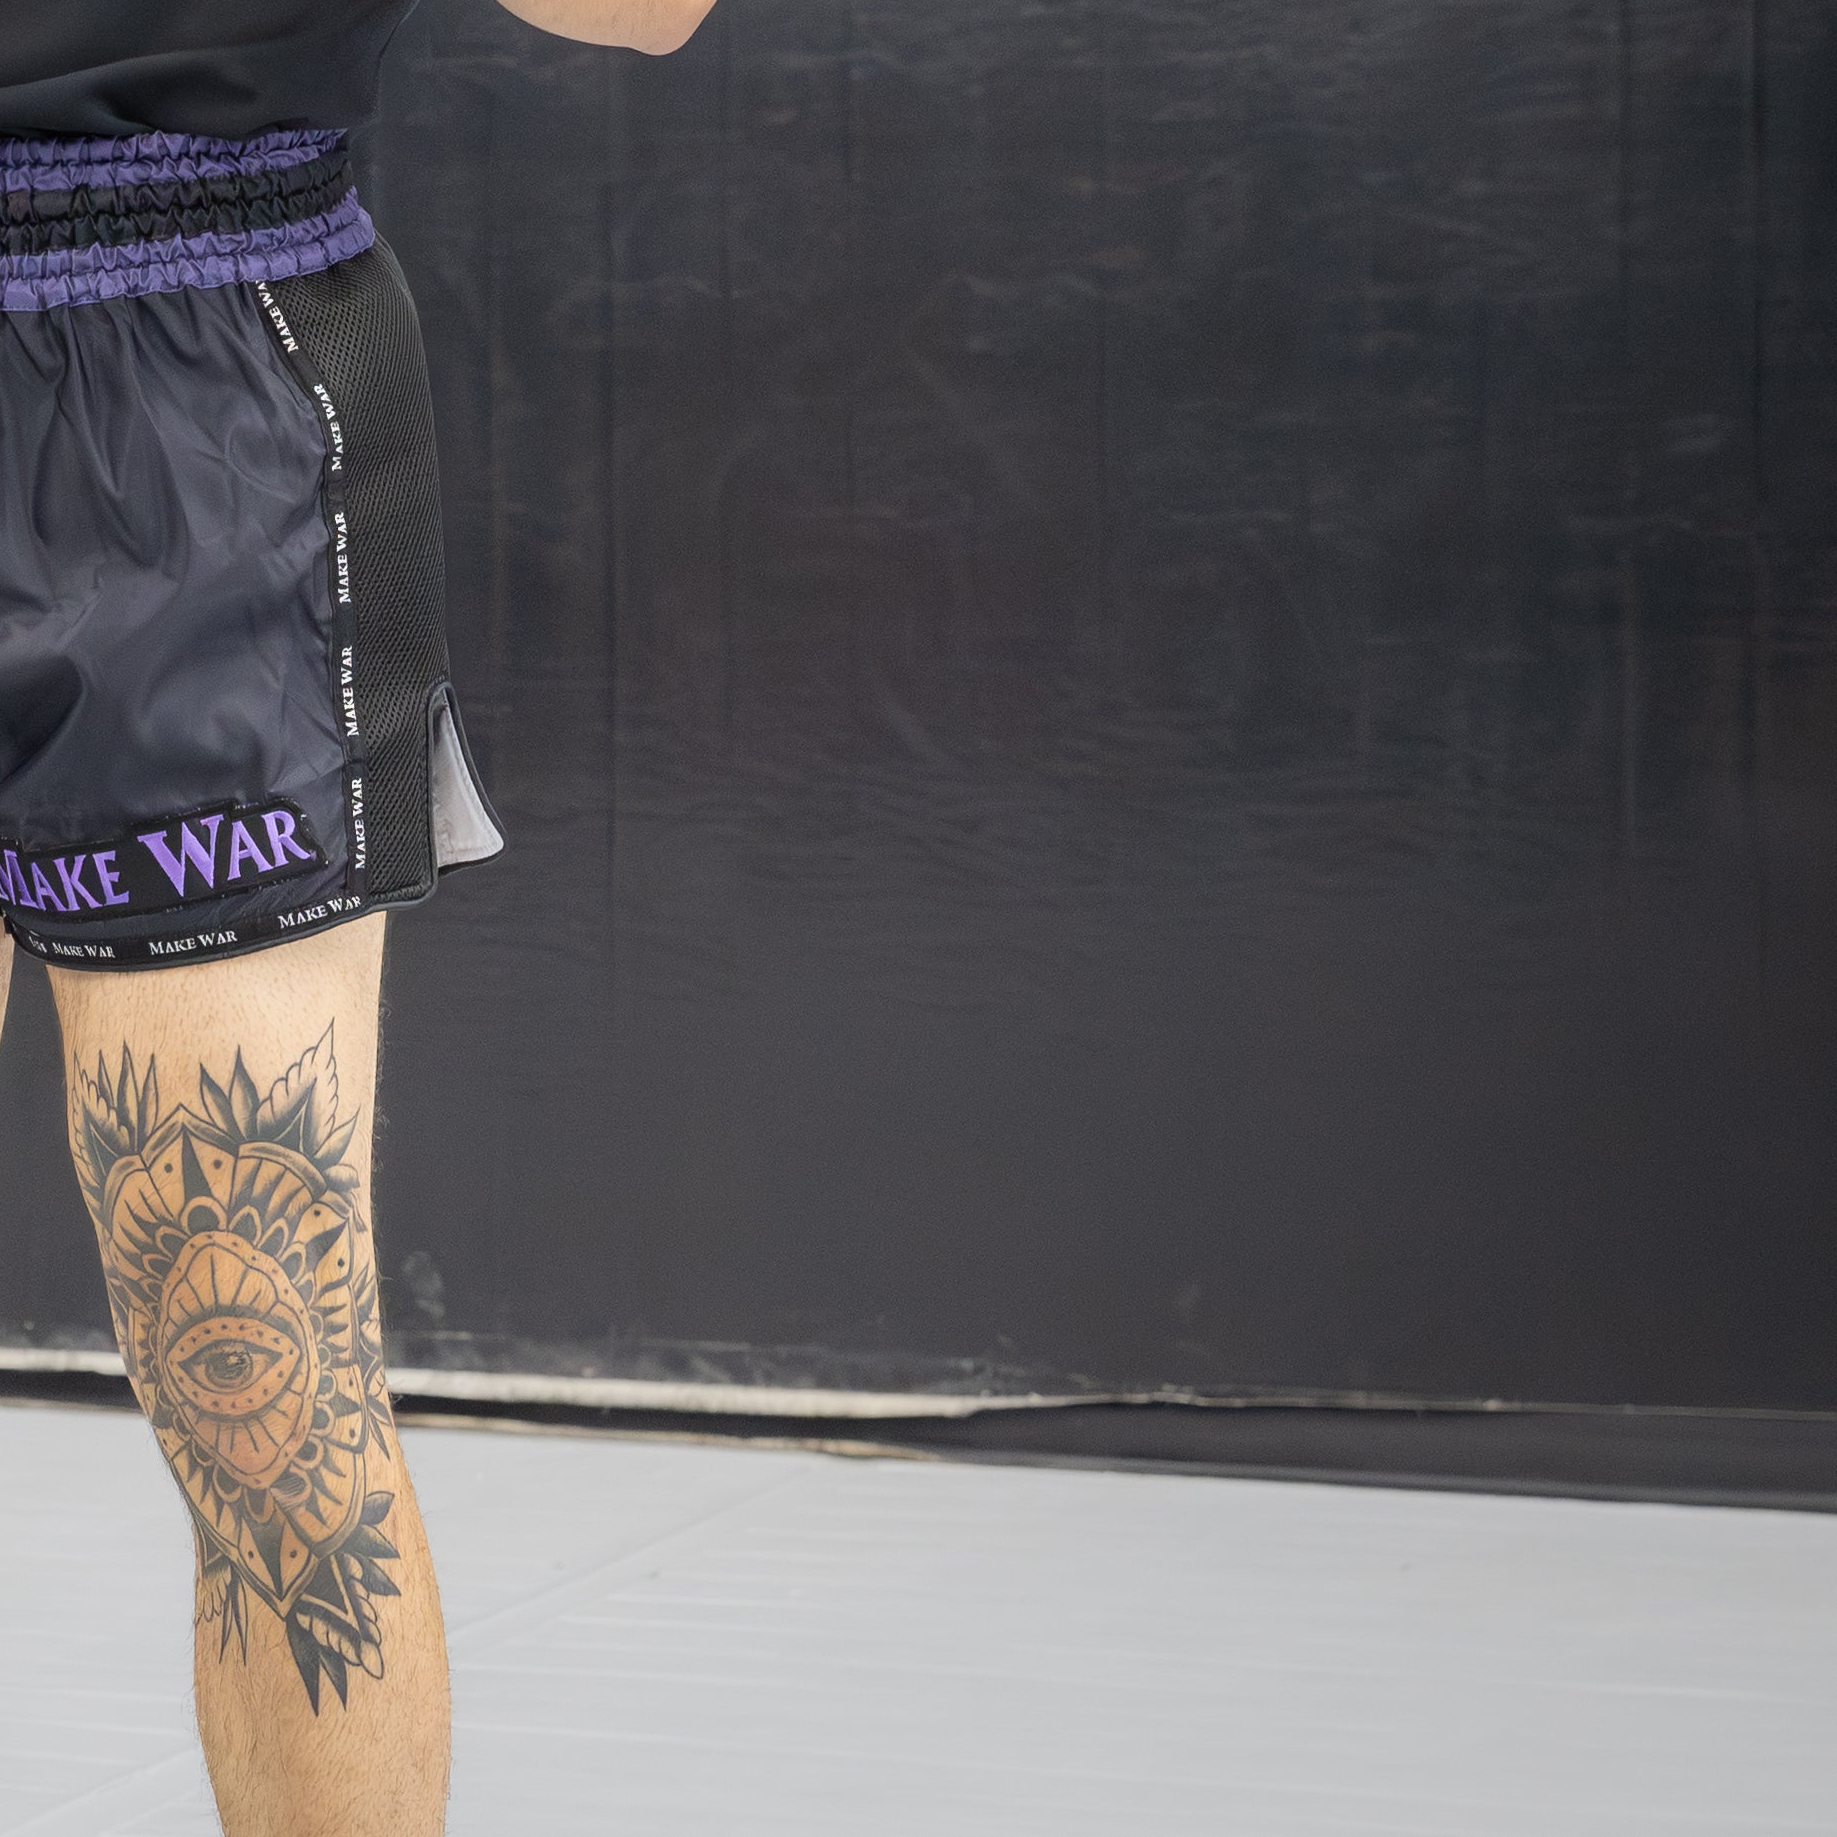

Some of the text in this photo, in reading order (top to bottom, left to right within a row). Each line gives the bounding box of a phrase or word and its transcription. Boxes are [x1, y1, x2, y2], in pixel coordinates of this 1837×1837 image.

[255, 279, 299, 353] MAKE WA
[314, 383, 344, 471] MAKE WAR
[334, 512, 352, 604] MAKE WAR
[341, 645, 359, 737] MAKE WAR
[137, 809, 313, 898] WAR
[351, 777, 366, 870] MAKE WAR
[52, 942, 85, 958] MAKE
[83, 944, 116, 959] WAR
[148, 930, 238, 956] MAKE WAR
[277, 895, 362, 930] MAKE WAR
